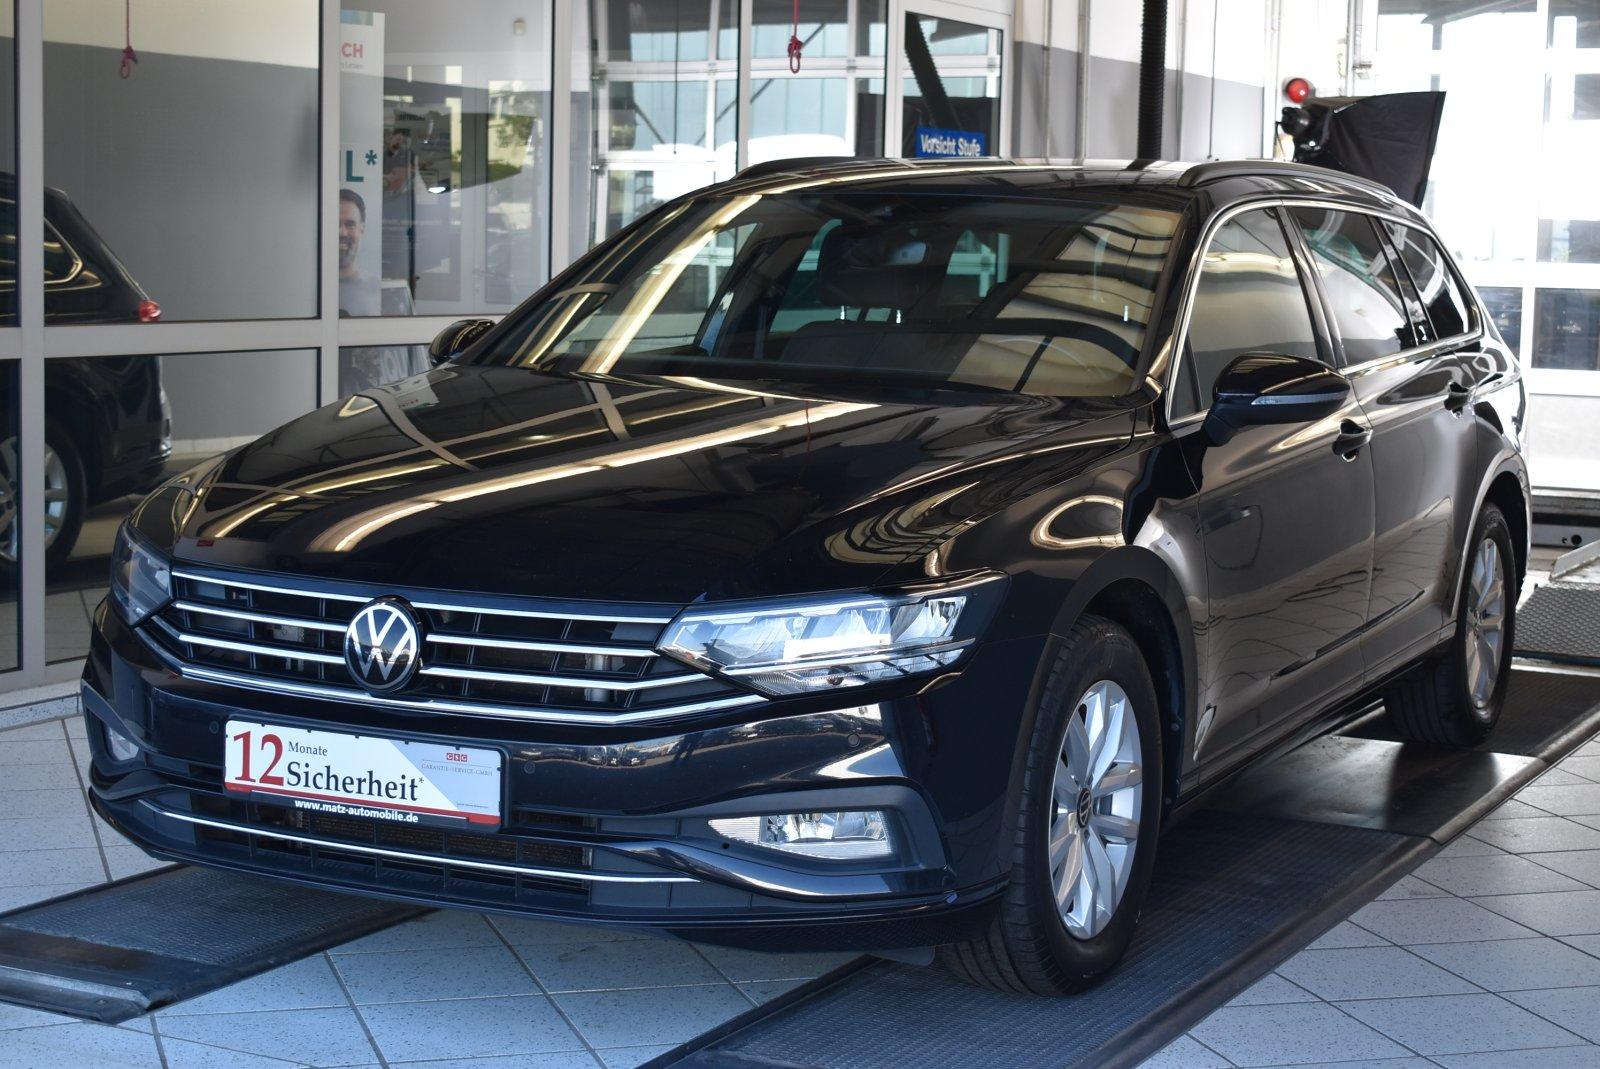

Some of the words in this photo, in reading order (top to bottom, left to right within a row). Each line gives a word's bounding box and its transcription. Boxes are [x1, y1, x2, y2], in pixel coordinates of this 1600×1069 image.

[920, 134, 956, 155] Vorsicht
[957, 137, 981, 157] Stufe
[233, 730, 285, 787] 12
[288, 741, 328, 757] Monate
[294, 799, 420, 824] www.matz-automobile.de
